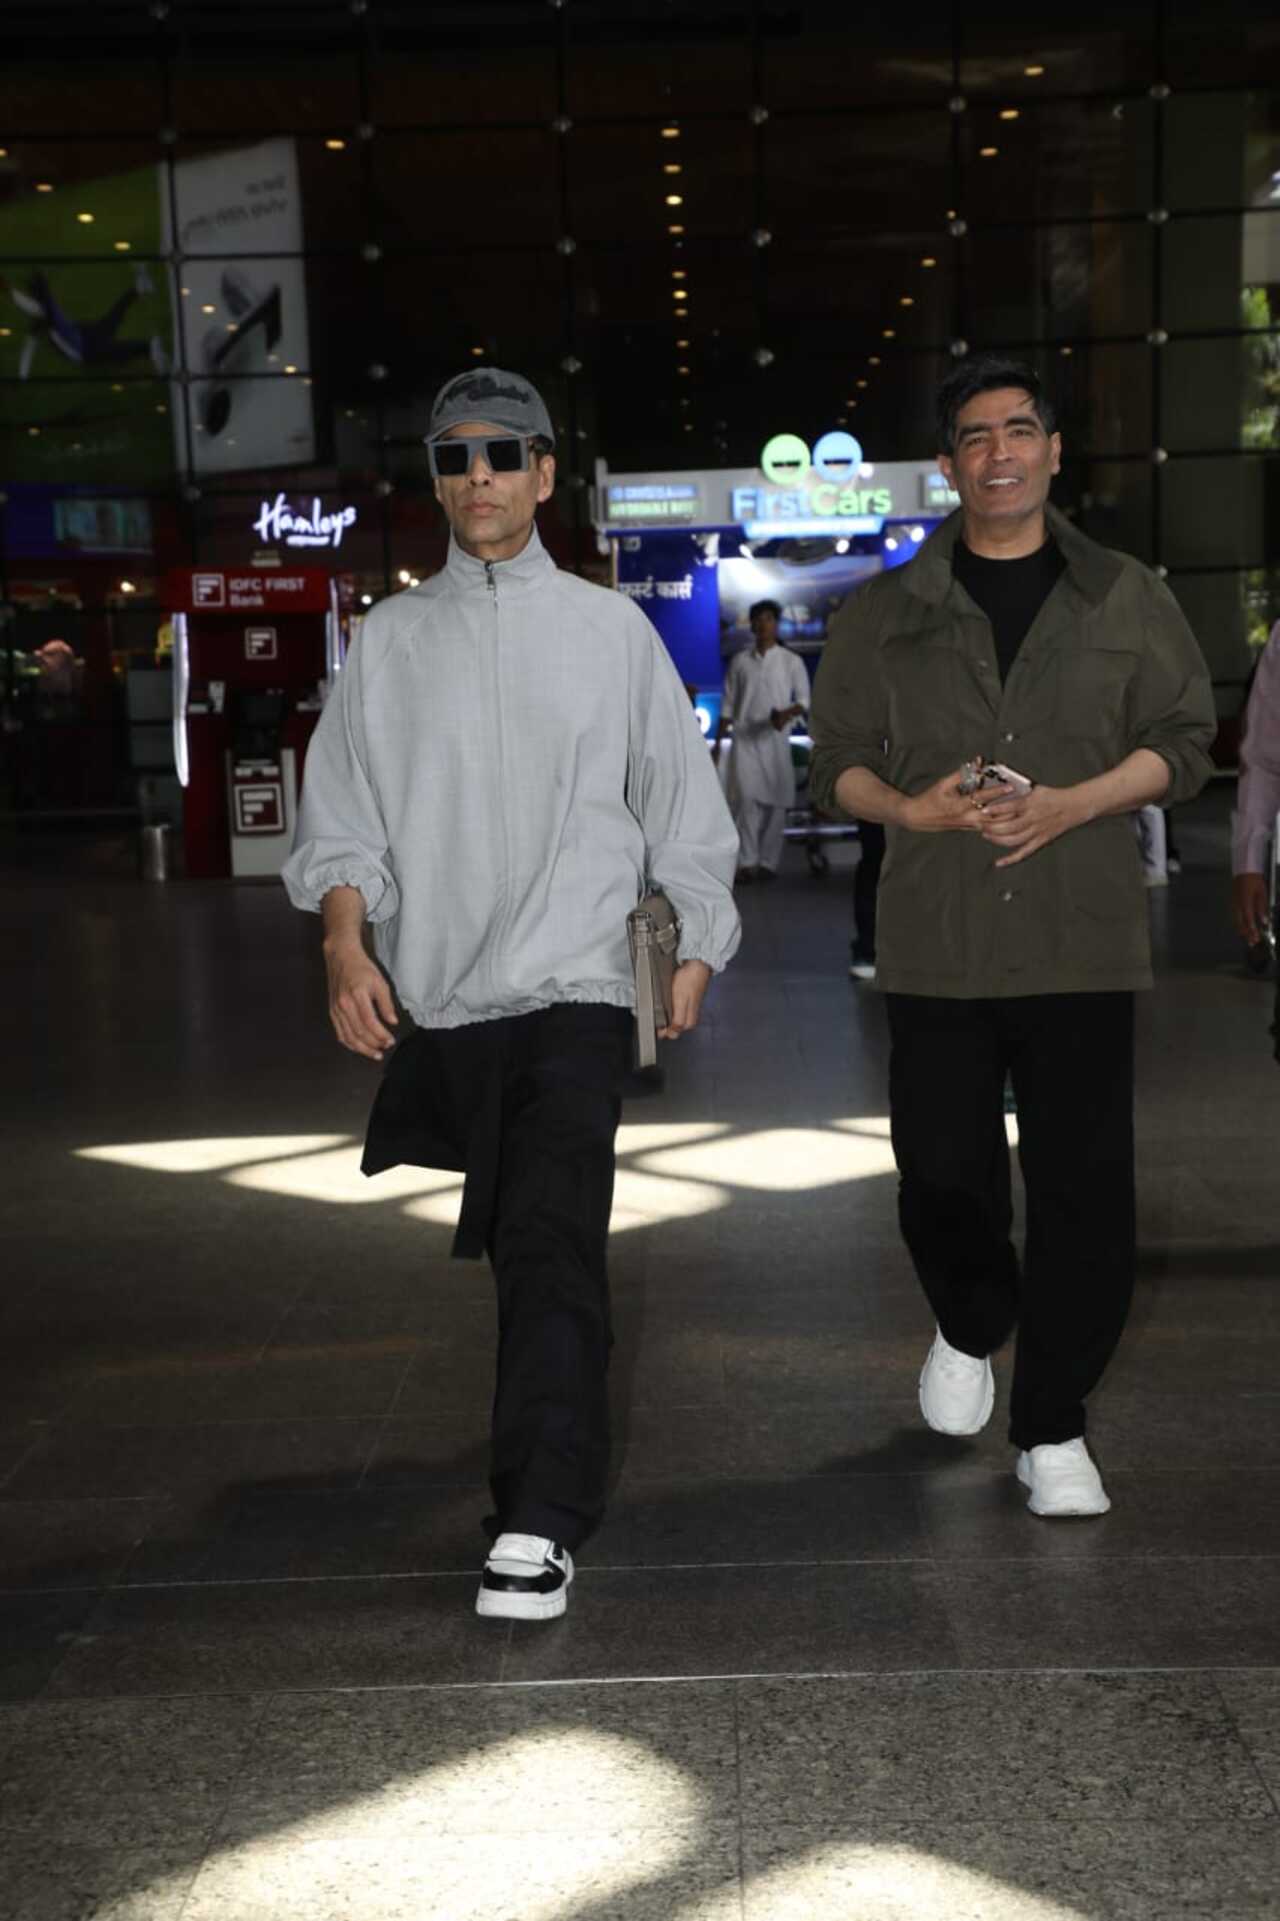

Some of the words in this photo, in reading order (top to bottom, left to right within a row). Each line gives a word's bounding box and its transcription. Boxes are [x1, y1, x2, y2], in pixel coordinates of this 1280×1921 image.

[252, 493, 356, 546] Hamleys
[229, 578, 261, 590] IDFC
[266, 577, 303, 590] FIRST
[229, 595, 262, 606] Bank
